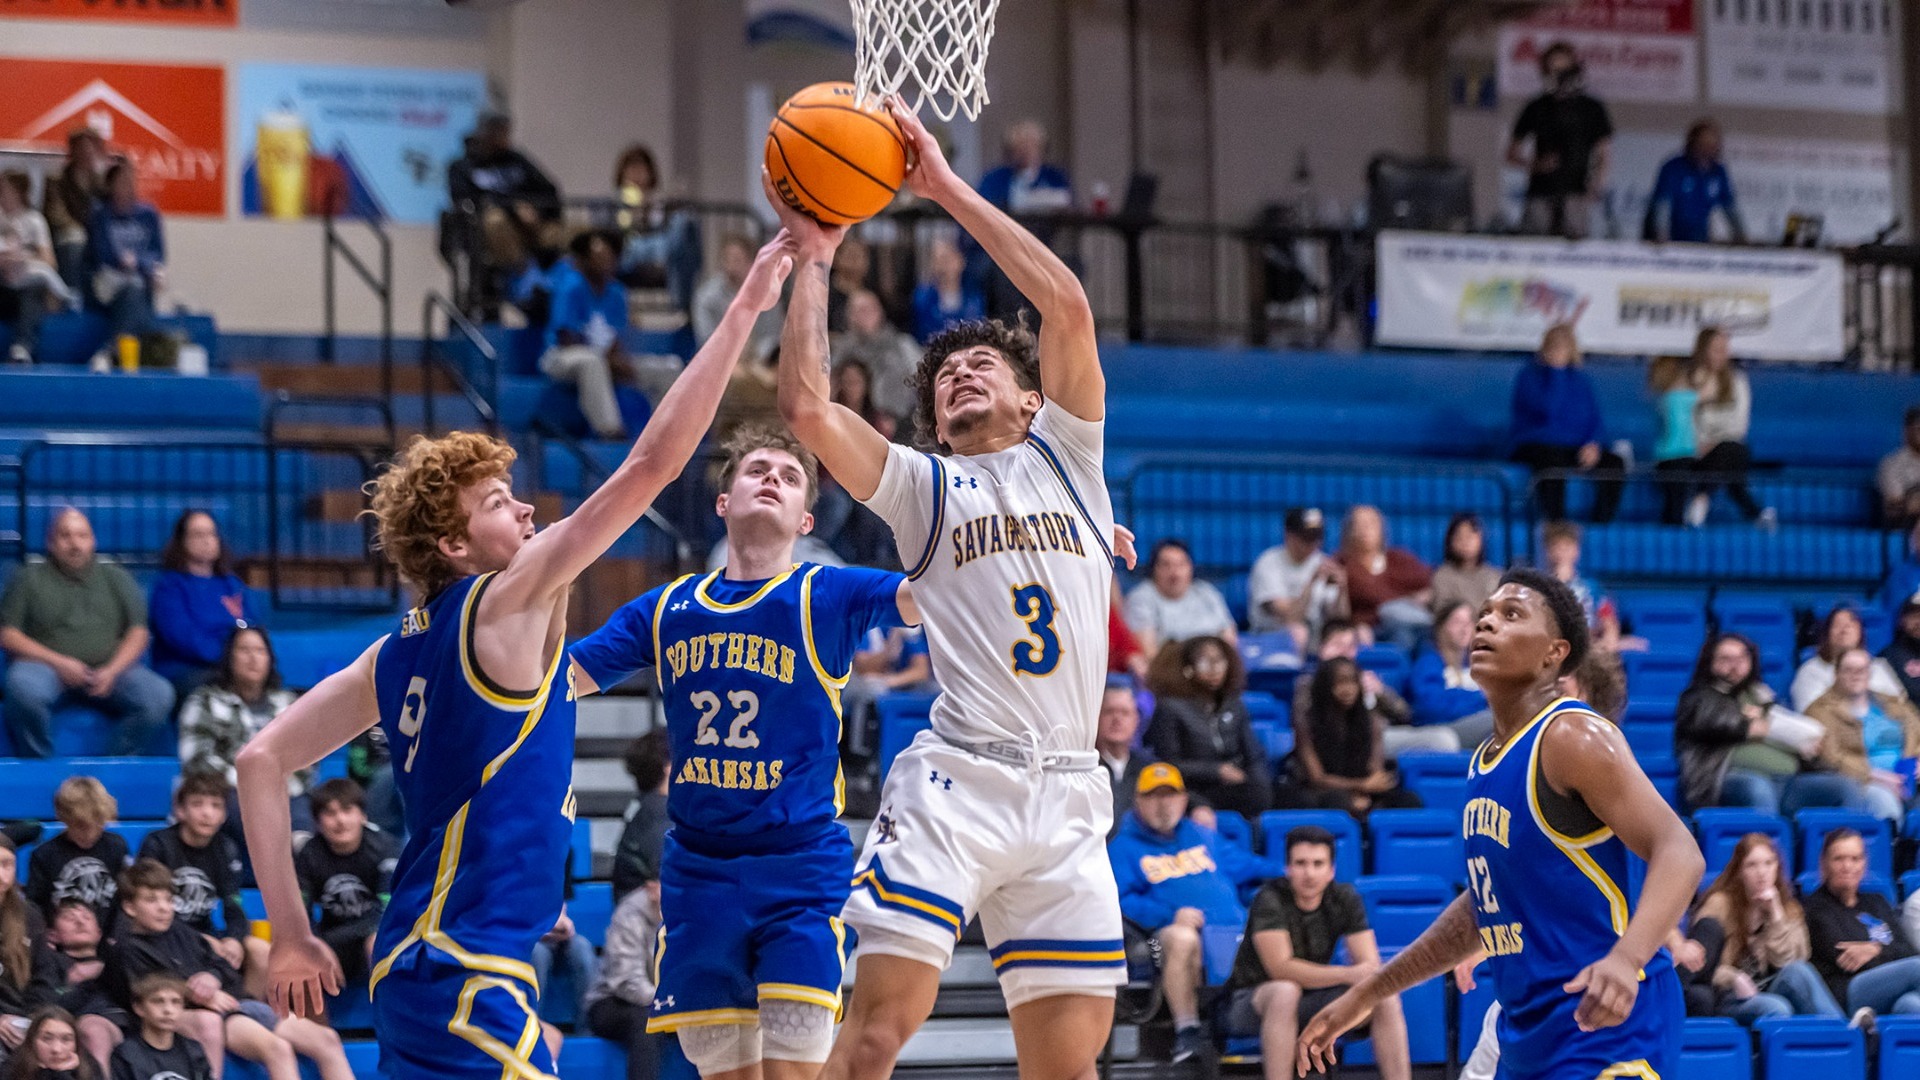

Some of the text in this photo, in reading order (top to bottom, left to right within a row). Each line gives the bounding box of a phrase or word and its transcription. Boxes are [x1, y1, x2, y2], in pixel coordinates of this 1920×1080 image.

[1022, 512, 1086, 558] STORM
[401, 609, 430, 637] SAU
[1011, 581, 1065, 678] 3
[665, 632, 796, 684] SOUTHERN
[398, 675, 427, 773] 9
[690, 690, 760, 748] 22
